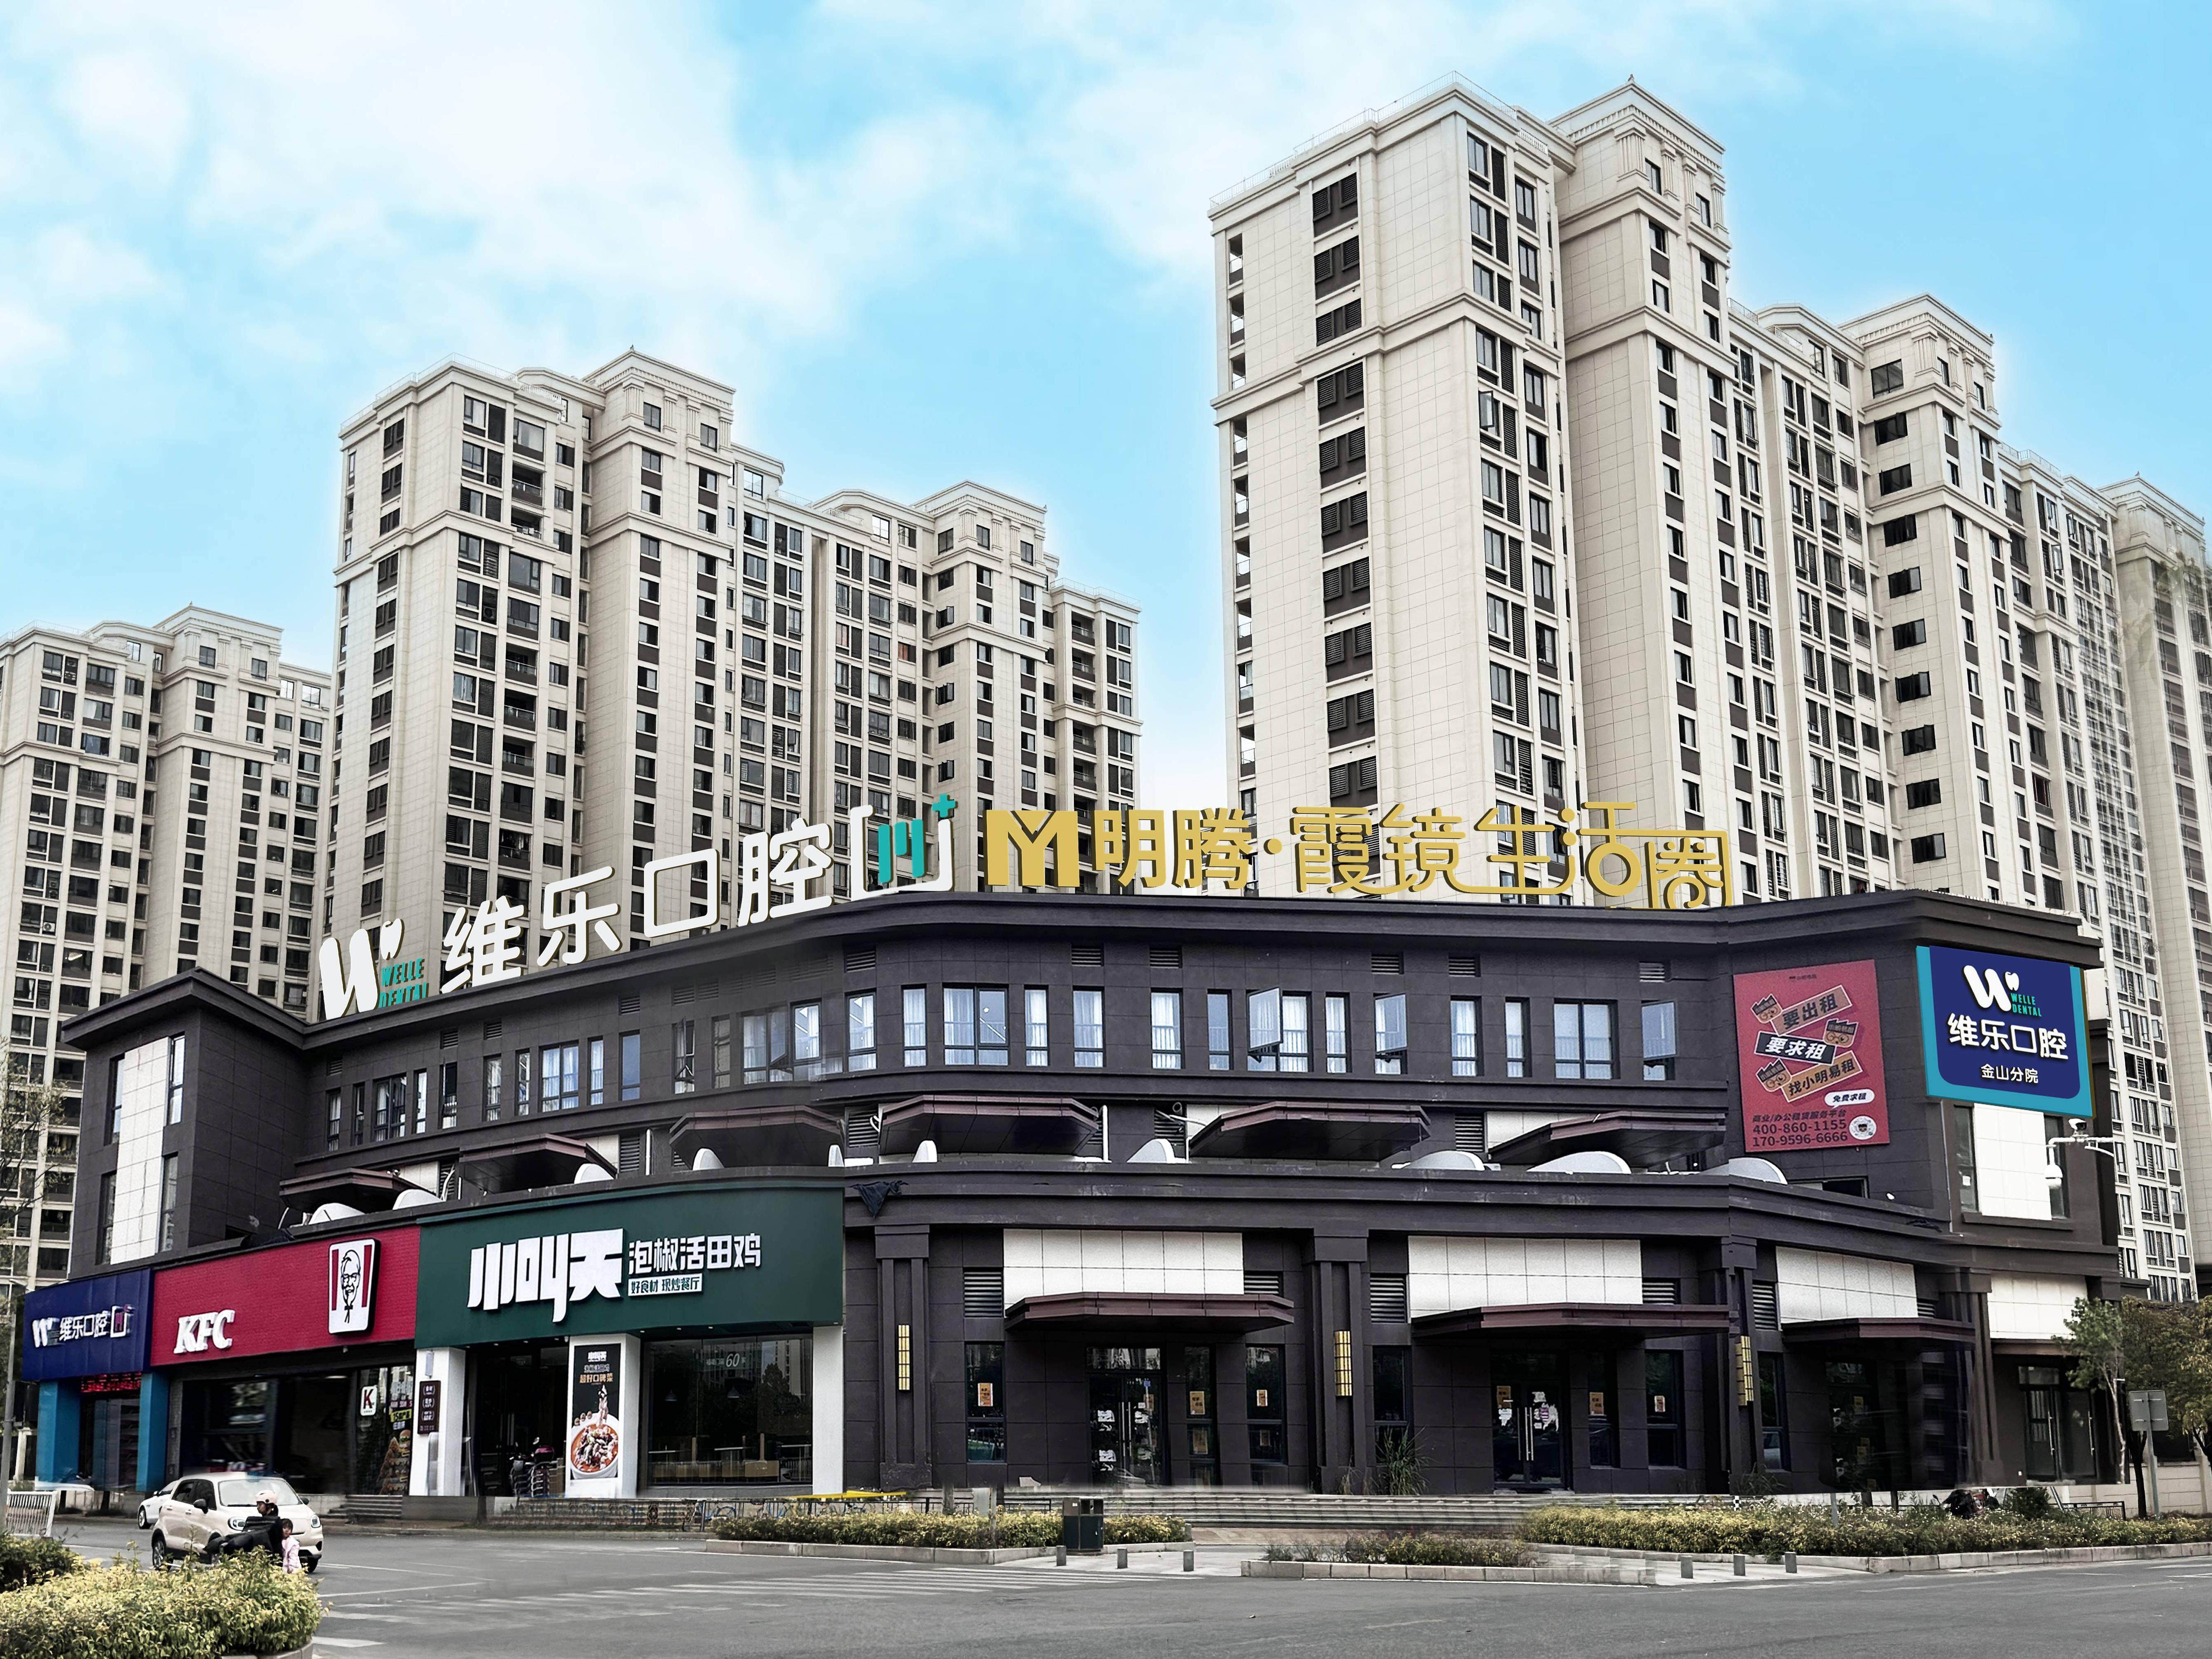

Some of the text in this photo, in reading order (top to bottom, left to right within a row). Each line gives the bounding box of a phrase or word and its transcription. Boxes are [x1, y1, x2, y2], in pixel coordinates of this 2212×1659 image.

[441, 818, 834, 994] 维乐口腔
[382, 958, 425, 987] WELLE
[1782, 993, 1838, 1029] 要出租
[2010, 993, 2035, 1006] WELLE
[2012, 1004, 2042, 1017] DENTAL
[1765, 1036, 1827, 1060] 要求租
[1947, 1013, 2069, 1060] 维乐口腔
[1788, 1059, 1855, 1096] 找小明易租
[1980, 1063, 2039, 1084] 金山分院
[1753, 1119, 1847, 1134] 400-860-1155
[1752, 1132, 1848, 1147] 170-9596-6666
[628, 1233, 761, 1275] 泡椒活田鸡
[631, 1277, 700, 1294] 好食材 现炒餐厅
[59, 1311, 110, 1341] 维乐口腔
[174, 1309, 235, 1354] KFC
[726, 1353, 740, 1367] 60
[363, 1389, 374, 1409] K
